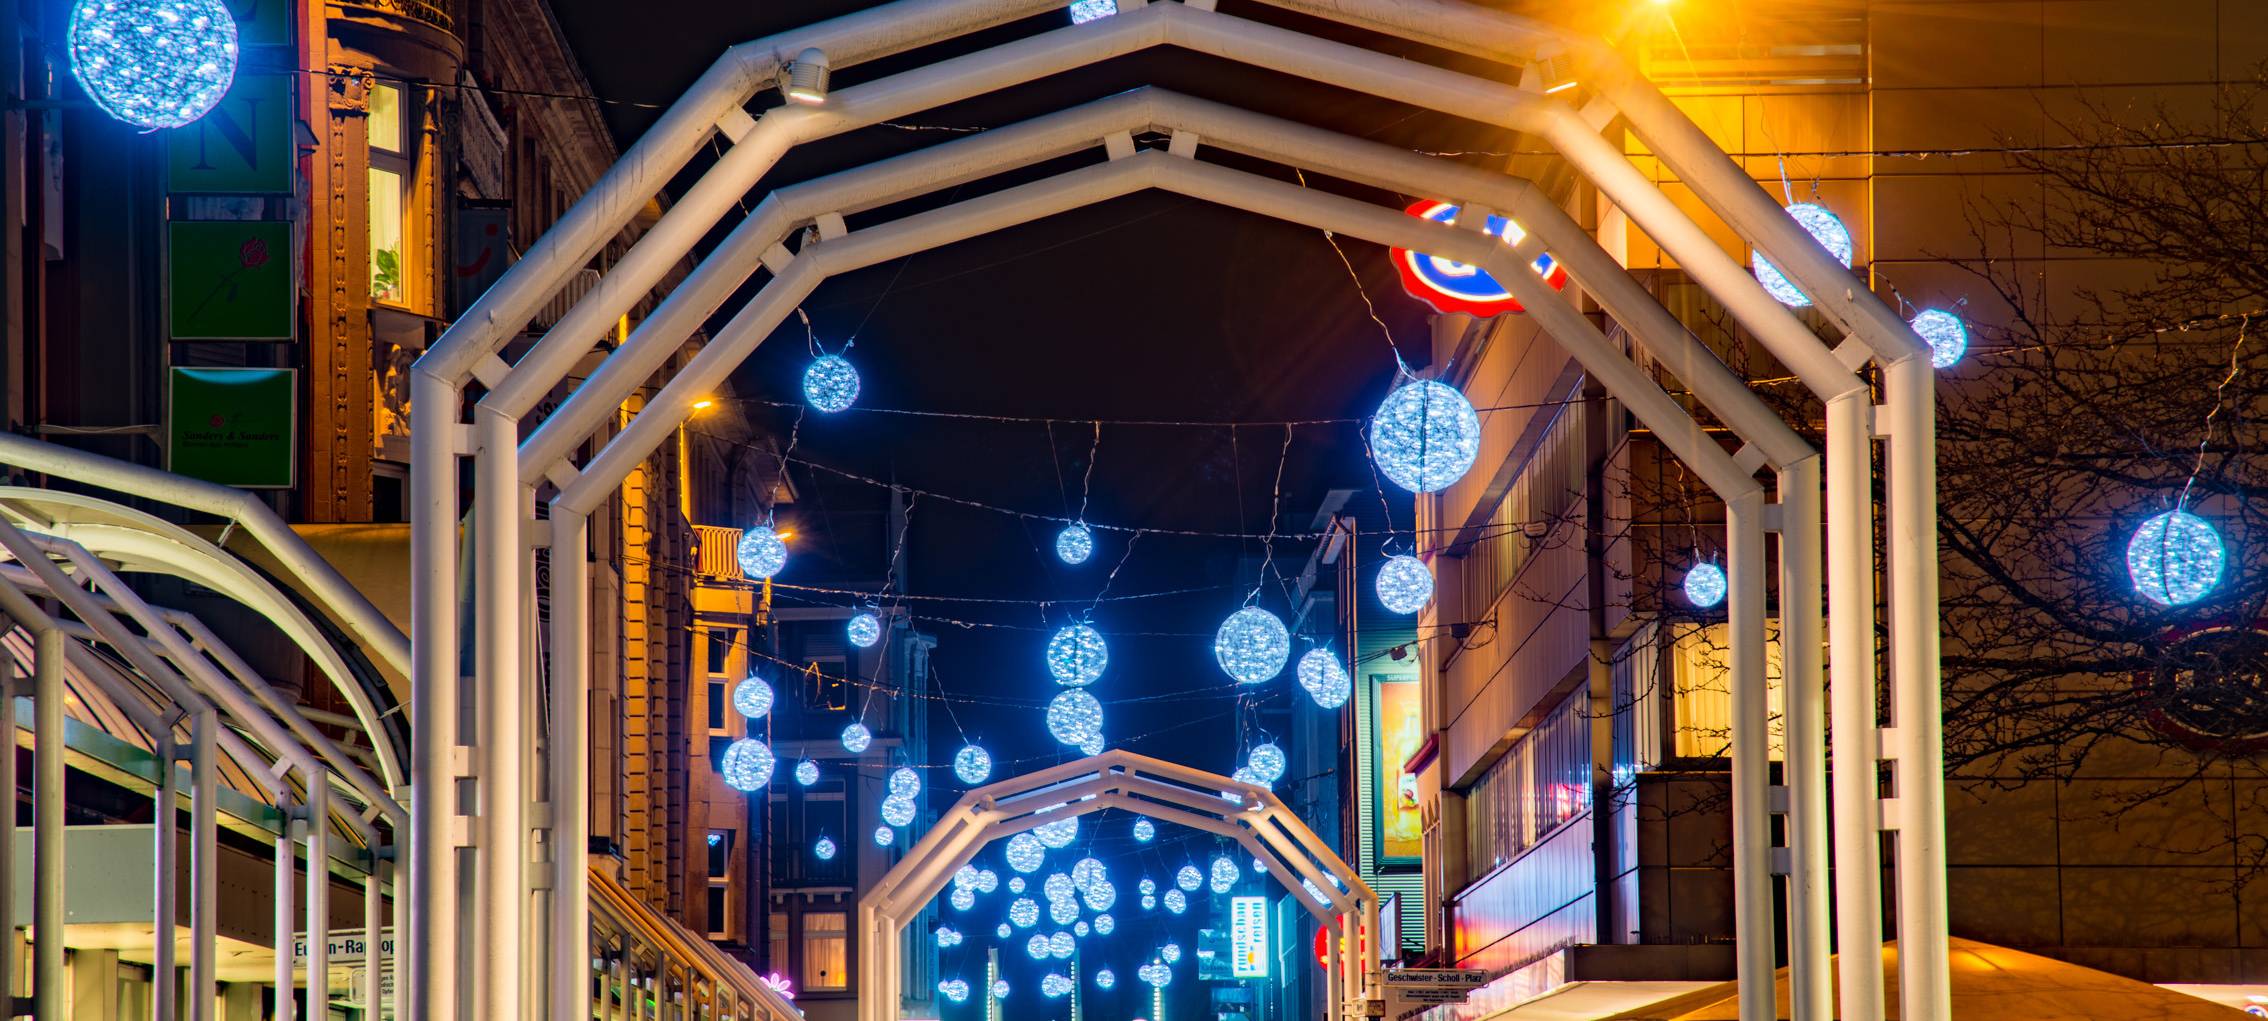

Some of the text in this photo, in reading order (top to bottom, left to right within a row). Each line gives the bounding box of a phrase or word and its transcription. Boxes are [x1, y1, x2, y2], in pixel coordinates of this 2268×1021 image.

[1235, 903, 1247, 971] rundschau
[1252, 902, 1262, 943] reisen
[1465, 974, 1483, 983] Platz
